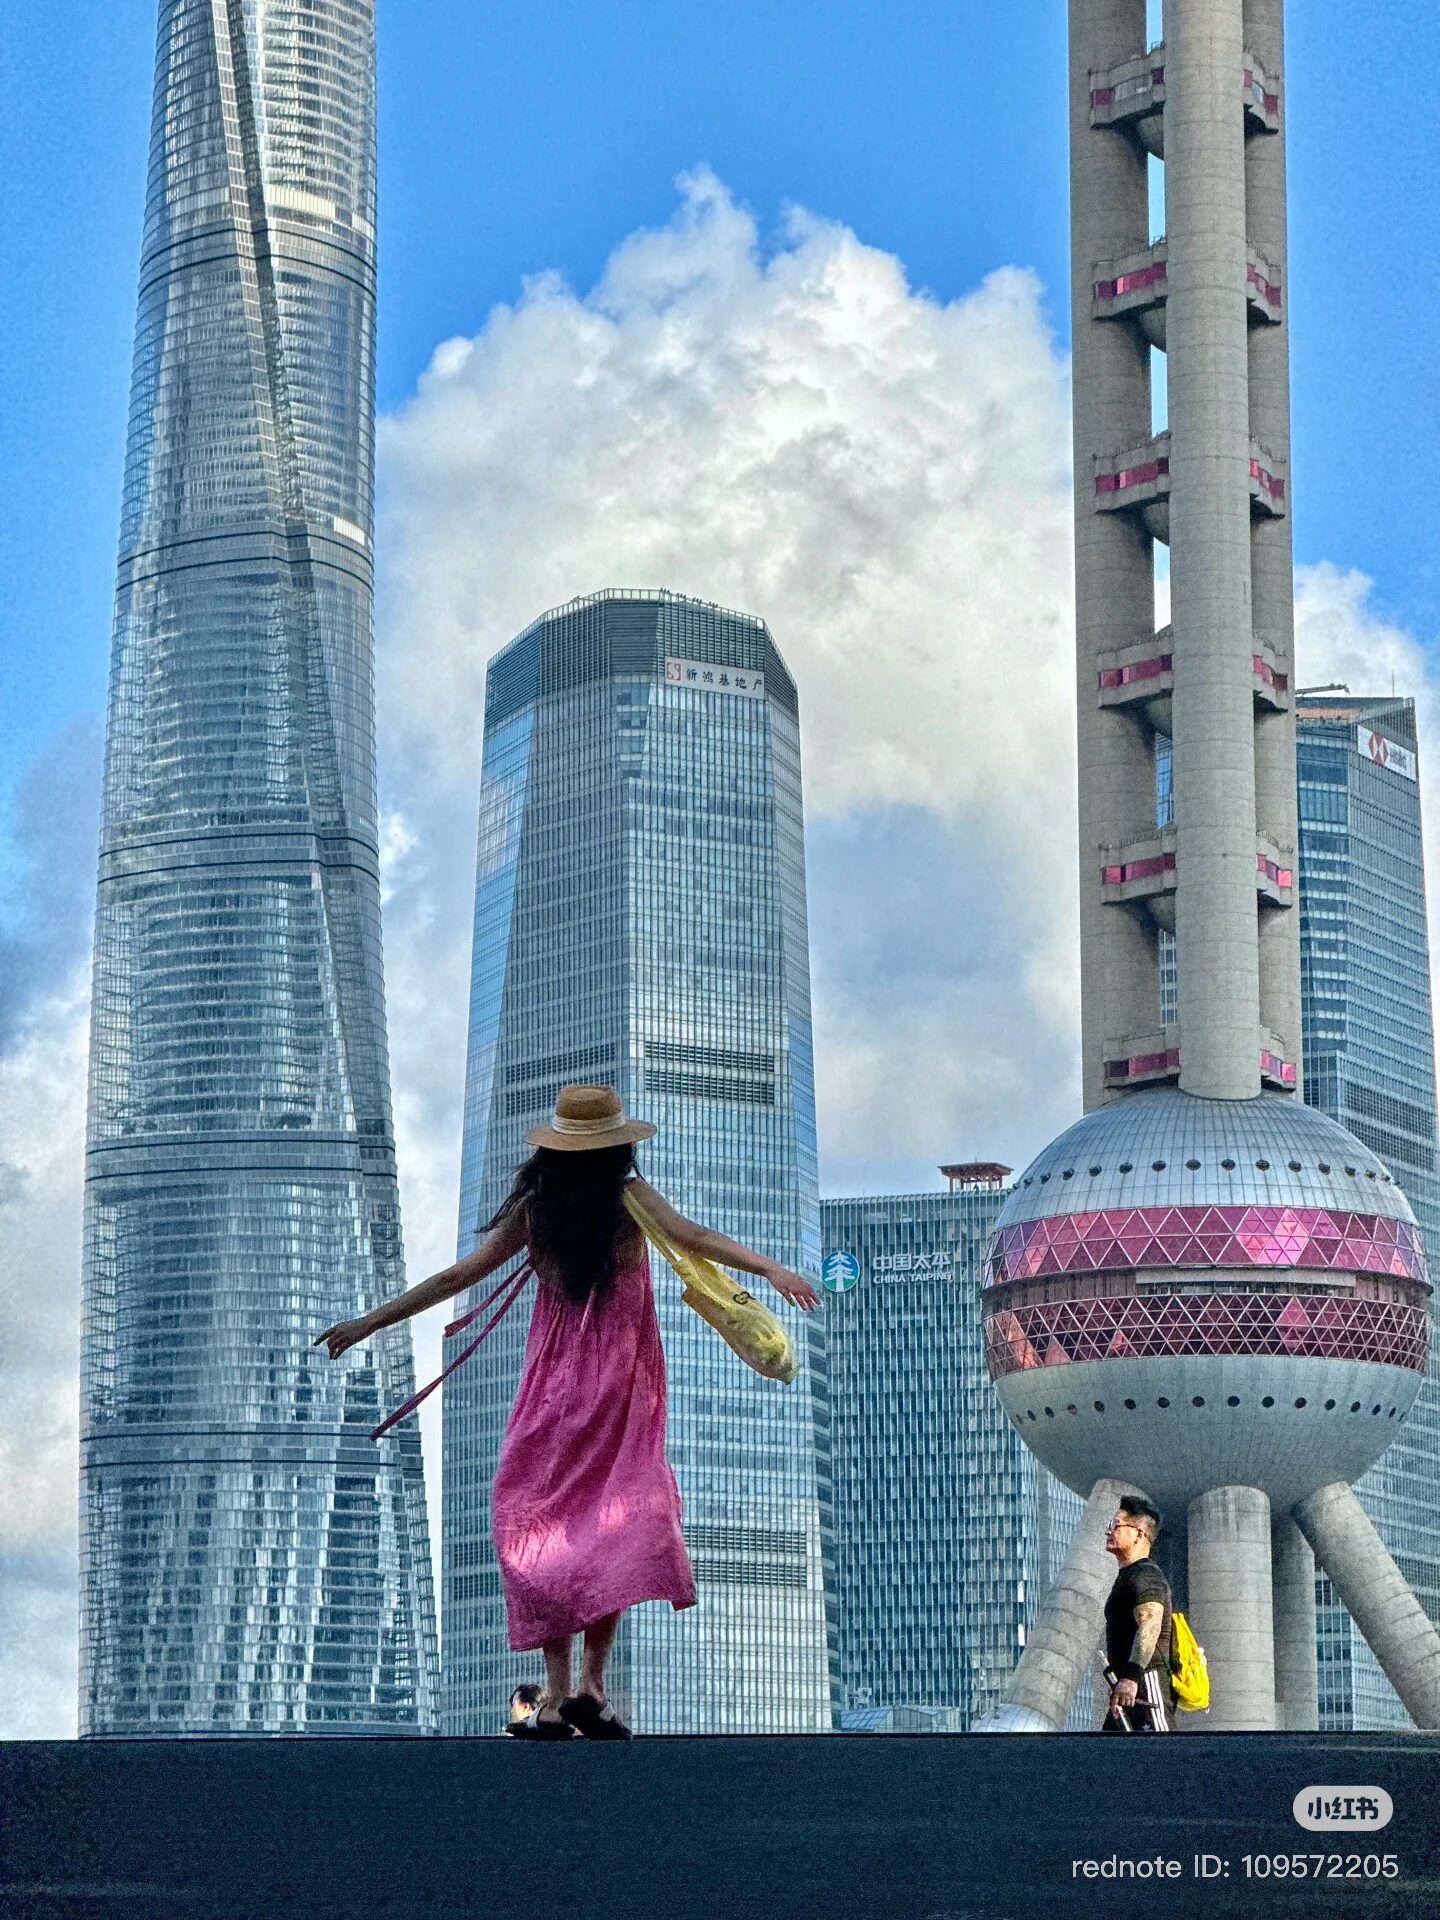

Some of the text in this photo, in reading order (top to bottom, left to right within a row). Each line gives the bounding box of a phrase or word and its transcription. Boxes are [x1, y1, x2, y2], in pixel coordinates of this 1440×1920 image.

[686, 668, 763, 691] 新鸿基地产
[872, 1251, 951, 1272] 中国太平
[873, 1272, 952, 1284] CHINA TAIPING
